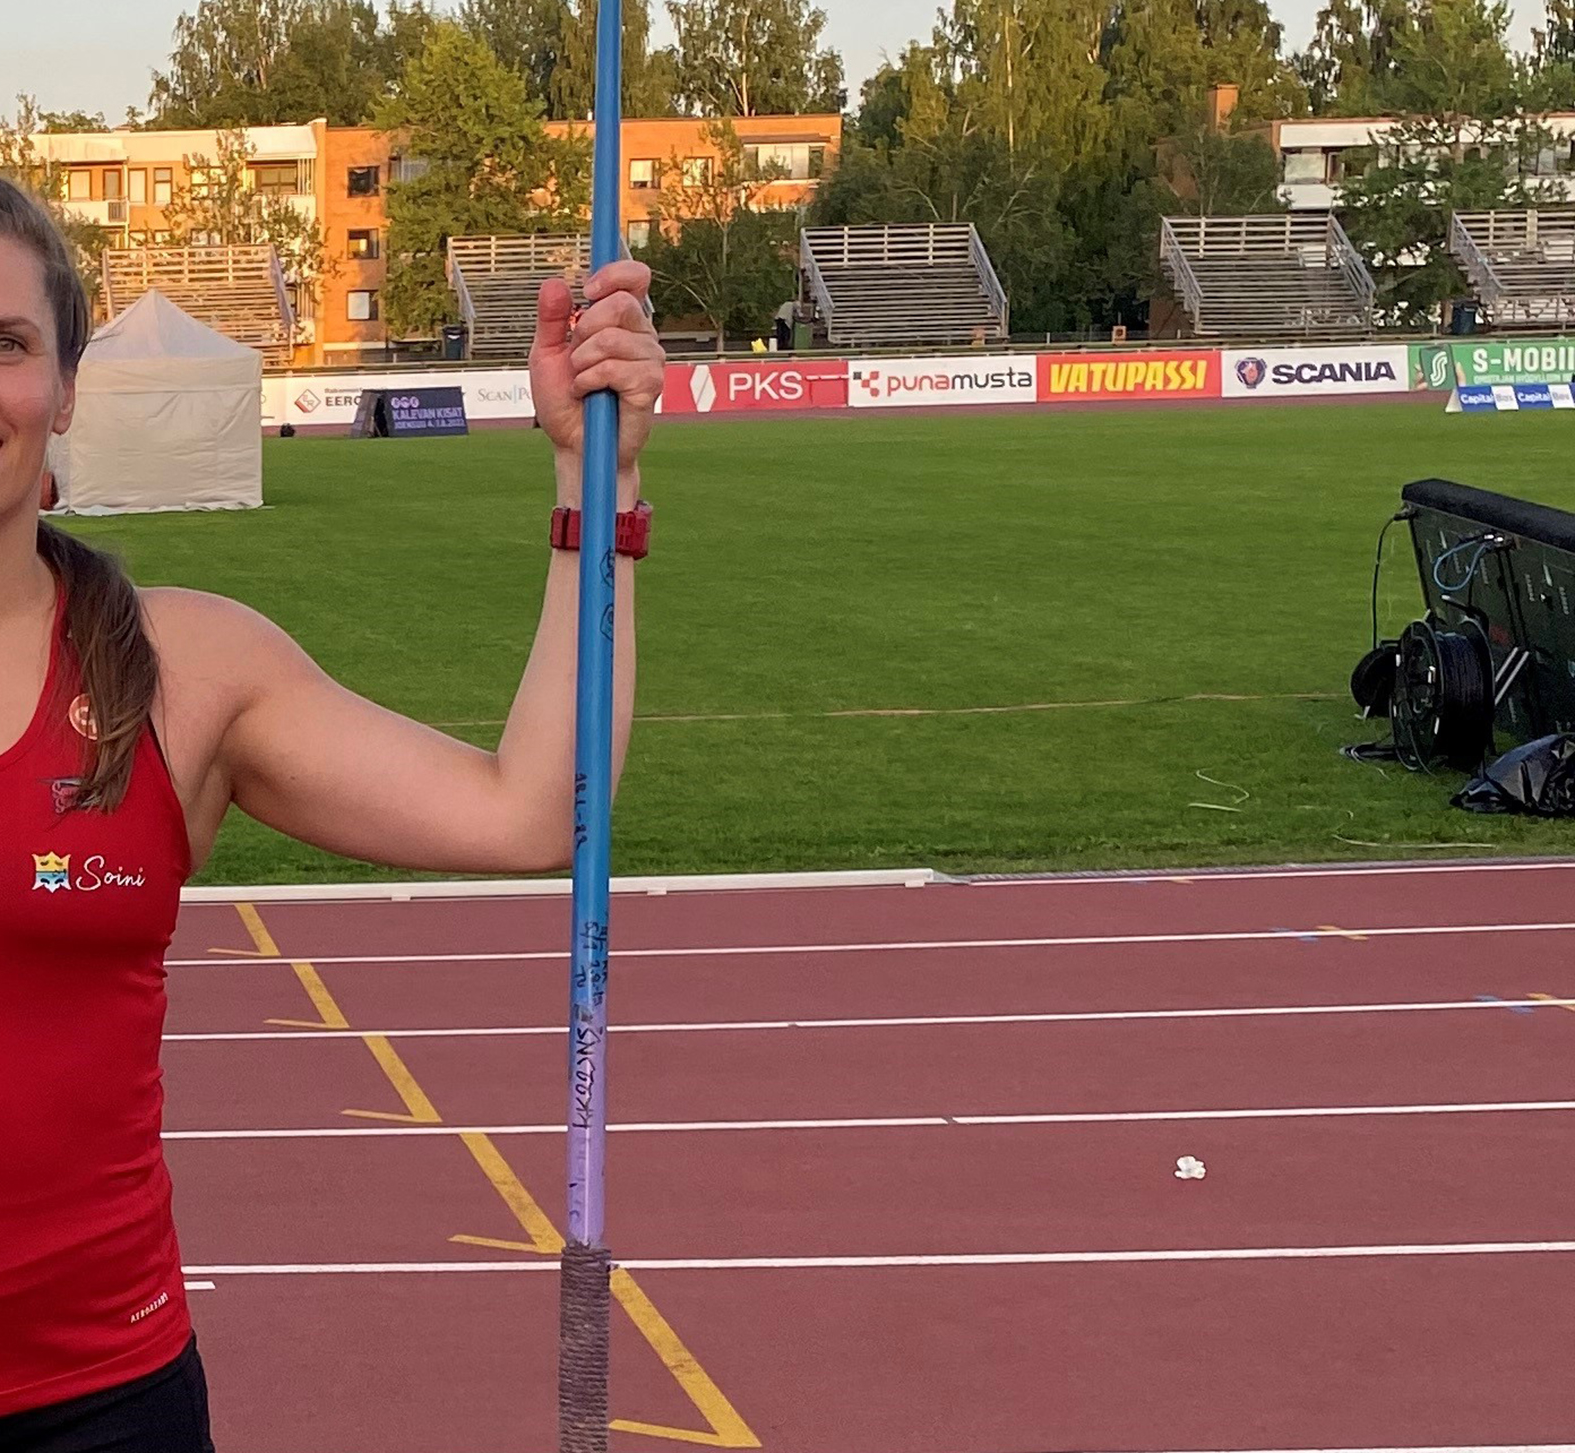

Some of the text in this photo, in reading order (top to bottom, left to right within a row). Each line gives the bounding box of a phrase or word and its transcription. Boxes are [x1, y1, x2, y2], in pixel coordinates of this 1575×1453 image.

[729, 371, 804, 401] PKS
[887, 367, 1033, 397] punamusta
[1049, 360, 1208, 394] VATUPASSI
[1272, 361, 1397, 385] SCANIA
[392, 407, 463, 420] KALEVAN KISAT
[76, 855, 146, 891] Soini
